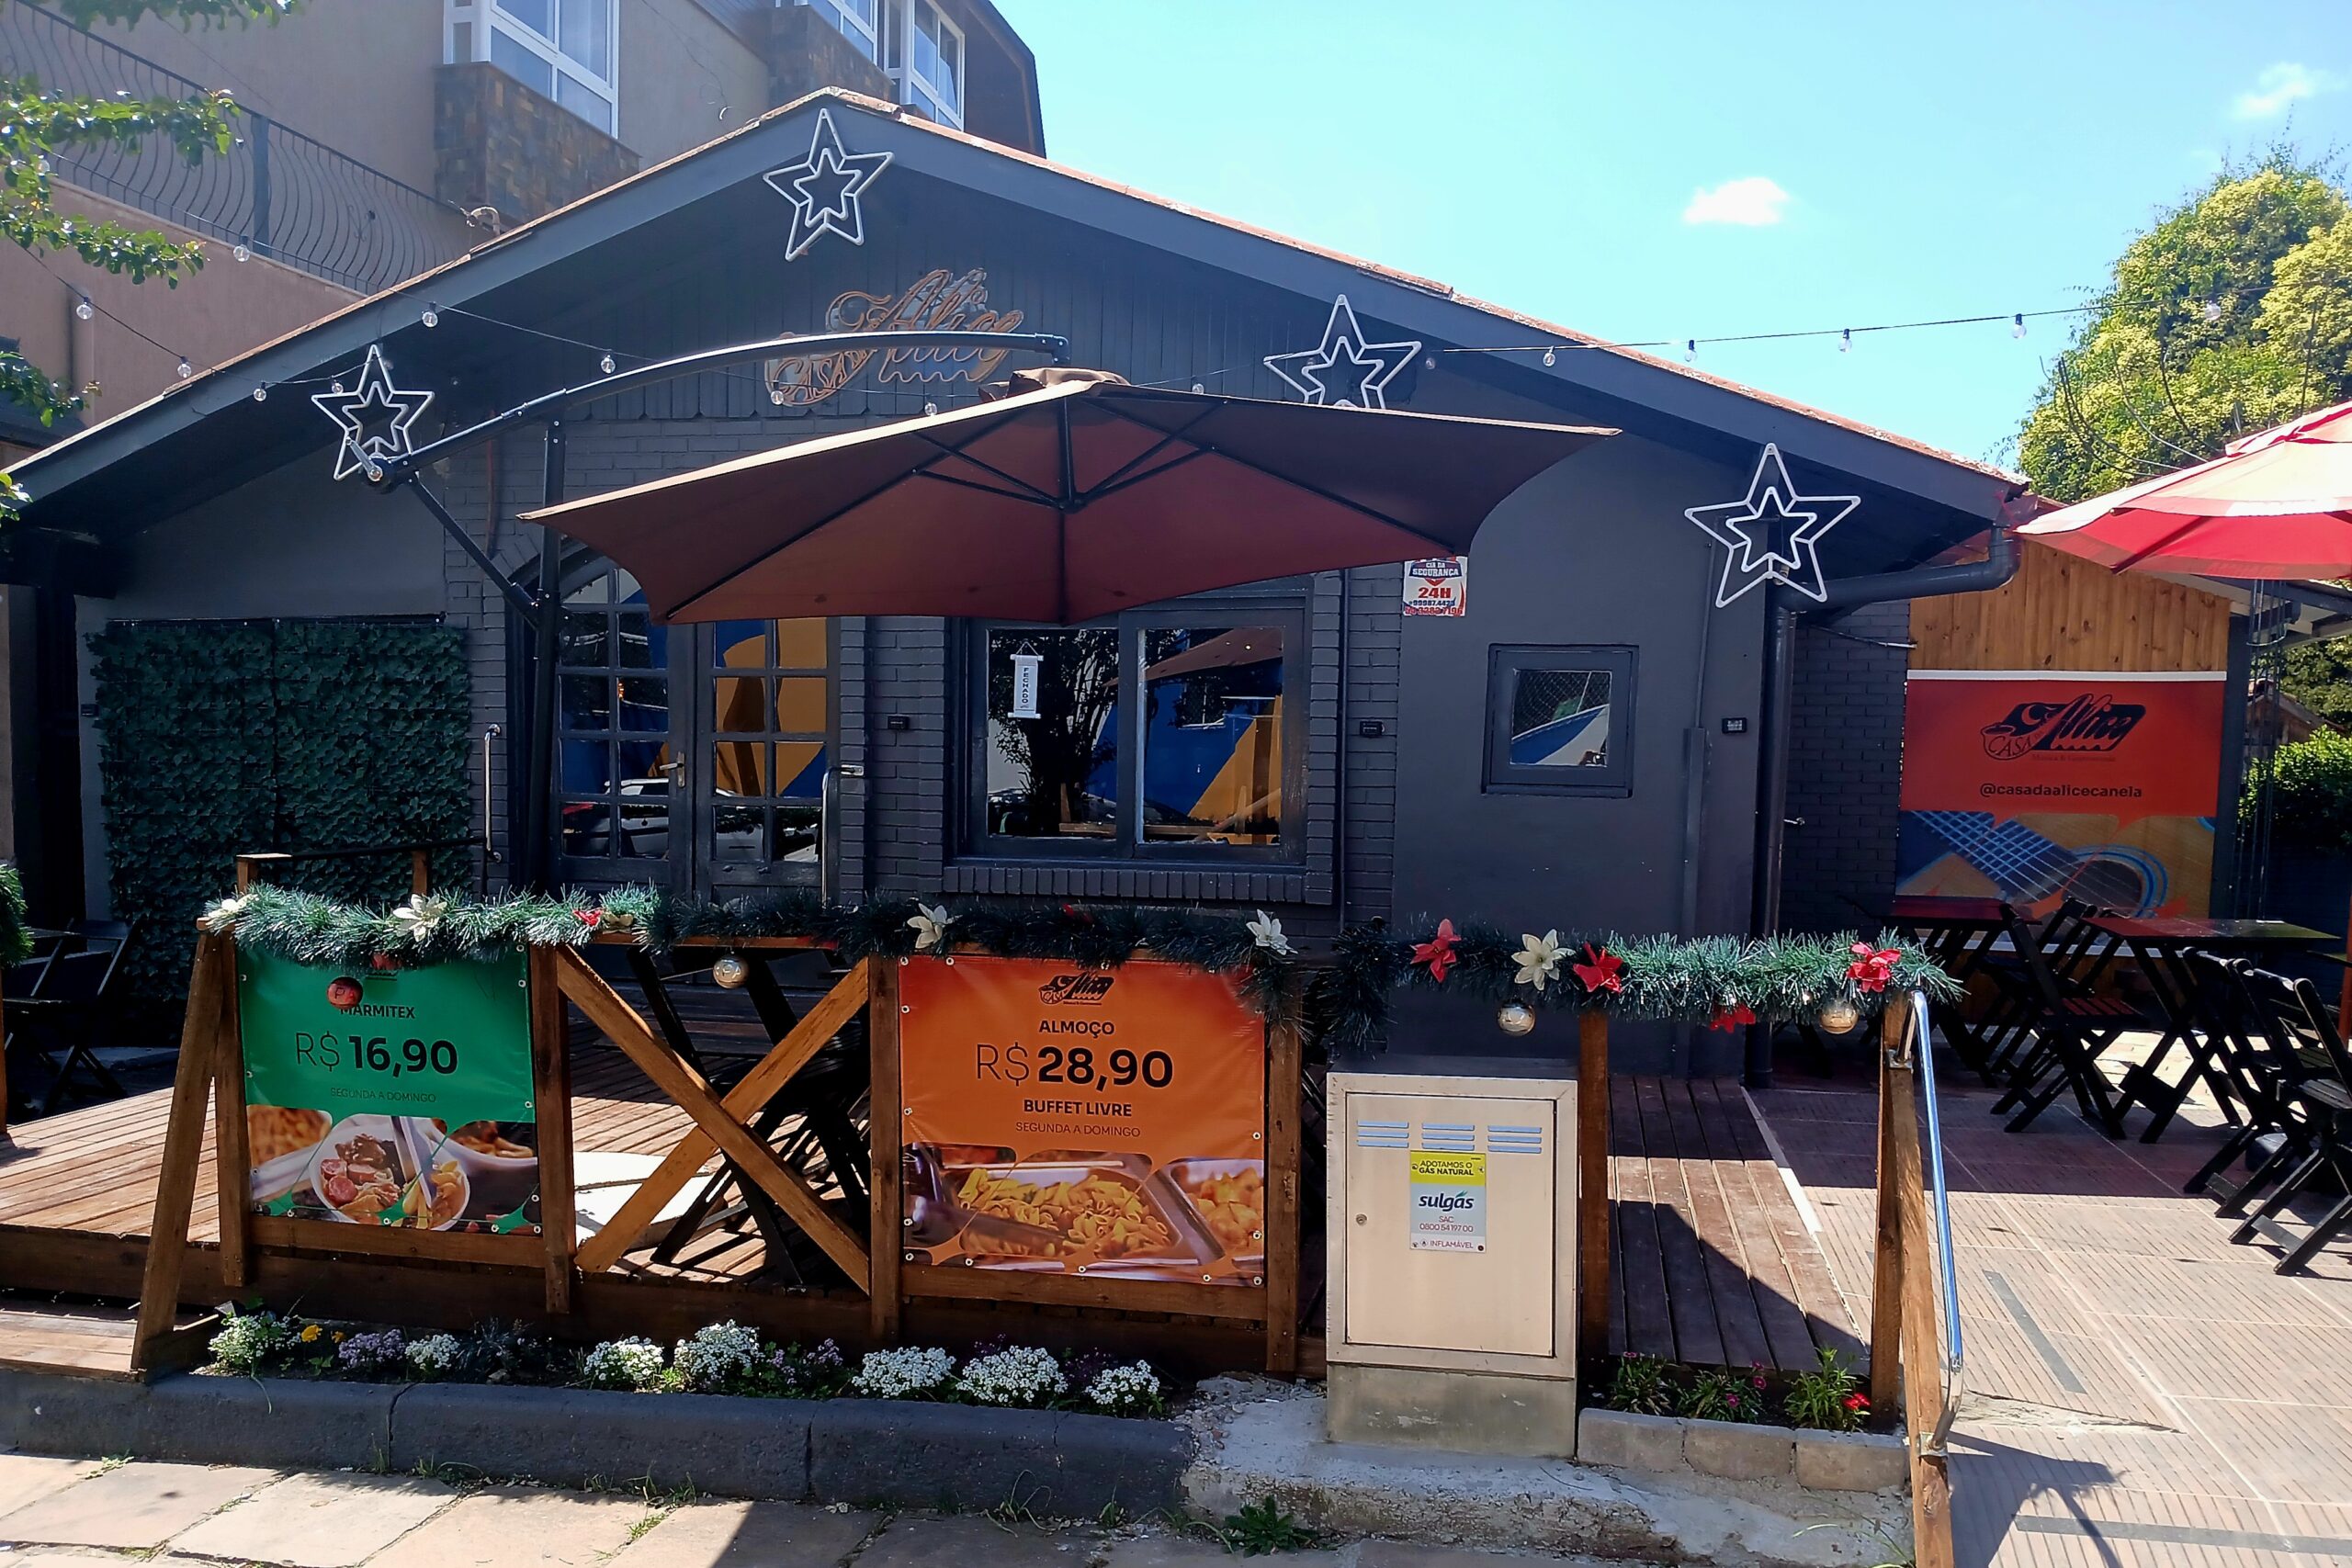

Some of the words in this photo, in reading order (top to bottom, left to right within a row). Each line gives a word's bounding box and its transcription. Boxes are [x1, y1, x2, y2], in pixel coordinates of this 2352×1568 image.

[1419, 587, 1452, 599] 24H
[1988, 735, 2032, 758] CASA
[1980, 783, 2143, 798] @casadaalicecanela
[1038, 1021, 1115, 1038] ALMOÇO
[296, 1031, 340, 1072] R$
[349, 1036, 458, 1077] 16,90
[977, 1042, 1030, 1087] R$
[1038, 1046, 1173, 1091] 28,90
[330, 1088, 377, 1100] SEGUNDA
[379, 1091, 386, 1100] A
[388, 1091, 436, 1103] DOMINGO
[1023, 1100, 1081, 1114] BUFFET
[1086, 1101, 1132, 1117] LIVRE
[1015, 1122, 1071, 1134] SEGUNDA
[1073, 1124, 1081, 1134] A
[1083, 1125, 1141, 1137] DOMINGO
[1419, 1160, 1464, 1168] ADOTAMOS
[1437, 1168, 1474, 1176] NATURAL
[1419, 1223, 1440, 1231] 0800
[1439, 1215, 1454, 1224] SAC
[1430, 1240, 1474, 1249] INFLAMÁVEL
